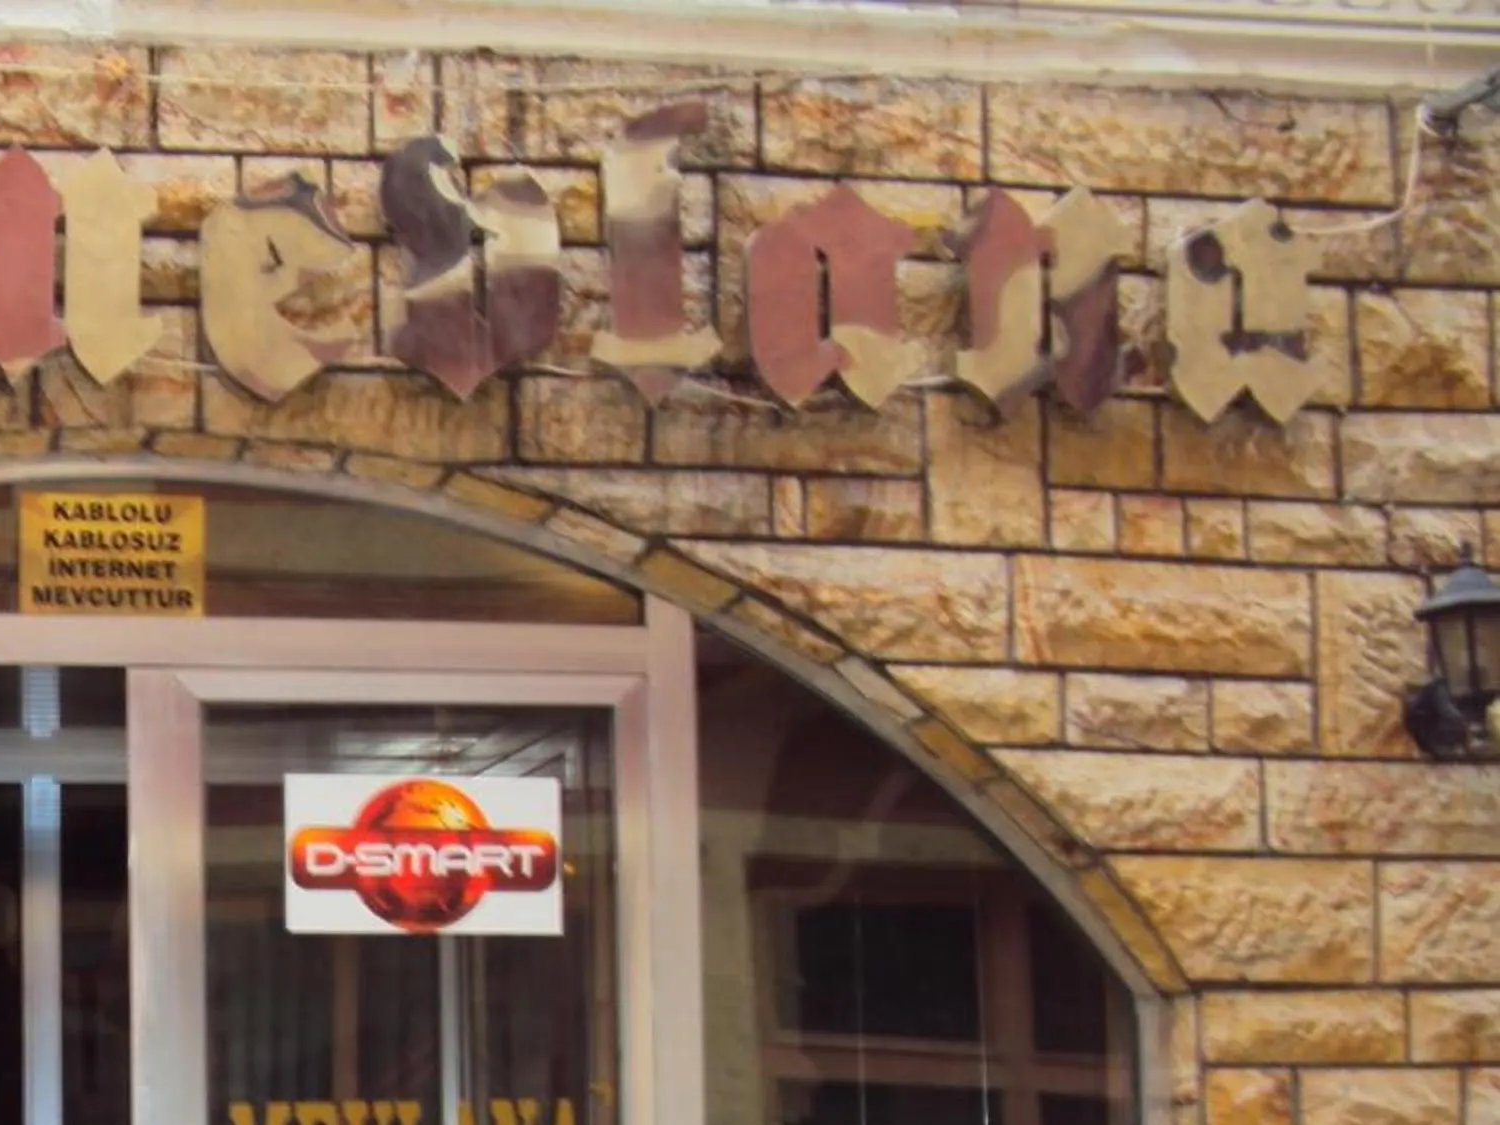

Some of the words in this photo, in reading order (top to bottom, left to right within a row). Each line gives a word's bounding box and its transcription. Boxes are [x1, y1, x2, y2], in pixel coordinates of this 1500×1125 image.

[53, 501, 172, 523] KABLOLU
[43, 529, 182, 553] KABLOSUZ
[49, 558, 177, 580] INTERNET
[32, 586, 194, 609] MEVCUTTUR
[304, 842, 545, 878] D-SMART
